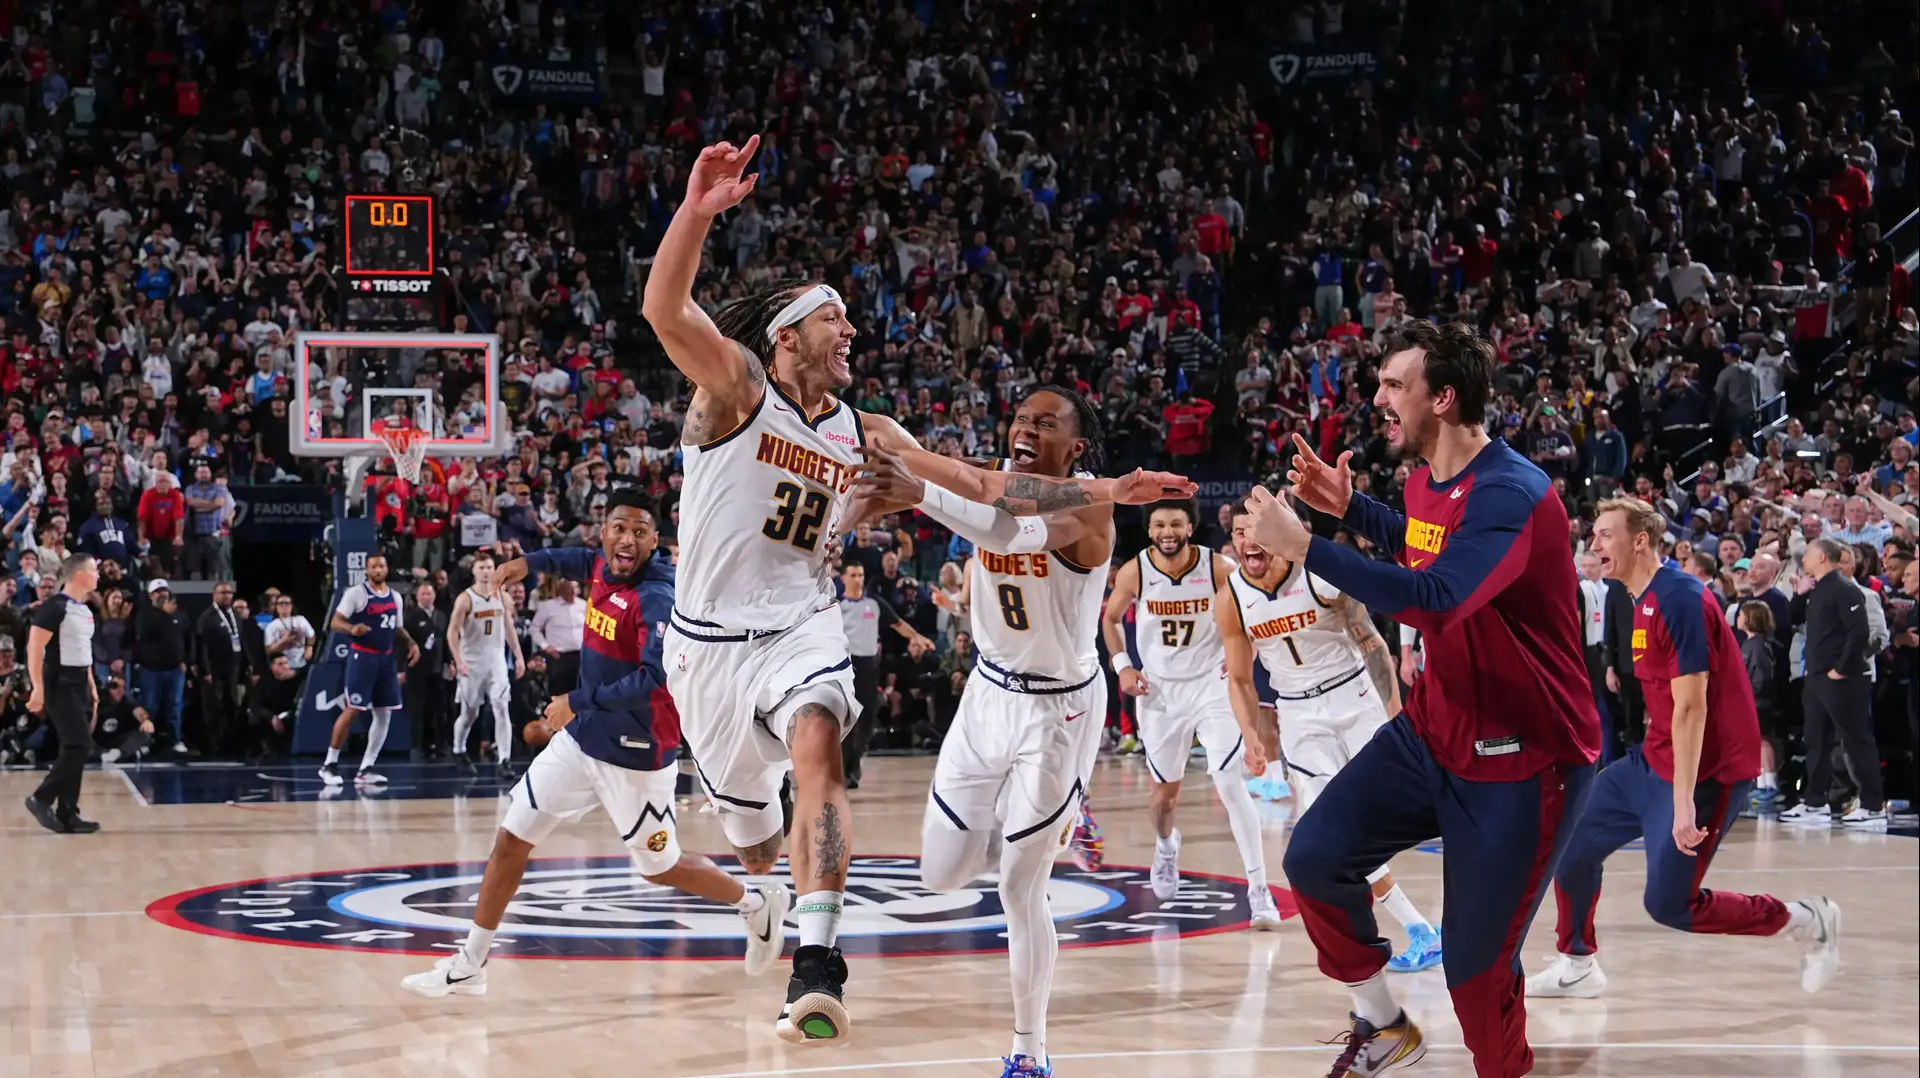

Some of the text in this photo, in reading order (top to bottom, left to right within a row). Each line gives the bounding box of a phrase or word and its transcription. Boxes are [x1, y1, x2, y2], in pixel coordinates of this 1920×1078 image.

[1306, 52, 1376, 68] FANDUEL
[528, 69, 594, 84] FANDUEL
[370, 202, 407, 226] 0.0
[373, 280, 431, 292] TISSOT
[826, 431, 855, 445] ibotta
[254, 503, 321, 515] FANDUEL
[762, 482, 830, 553] 32
[99, 529, 125, 544] USA
[347, 552, 367, 569] GET
[998, 583, 1030, 631] 8
[1147, 598, 1209, 615] NUGGETS
[380, 614, 397, 630] 24
[484, 620, 493, 635] 0
[1249, 609, 1317, 640] NUGGETS
[1161, 620, 1195, 647] 27
[1282, 635, 1303, 667] 1
